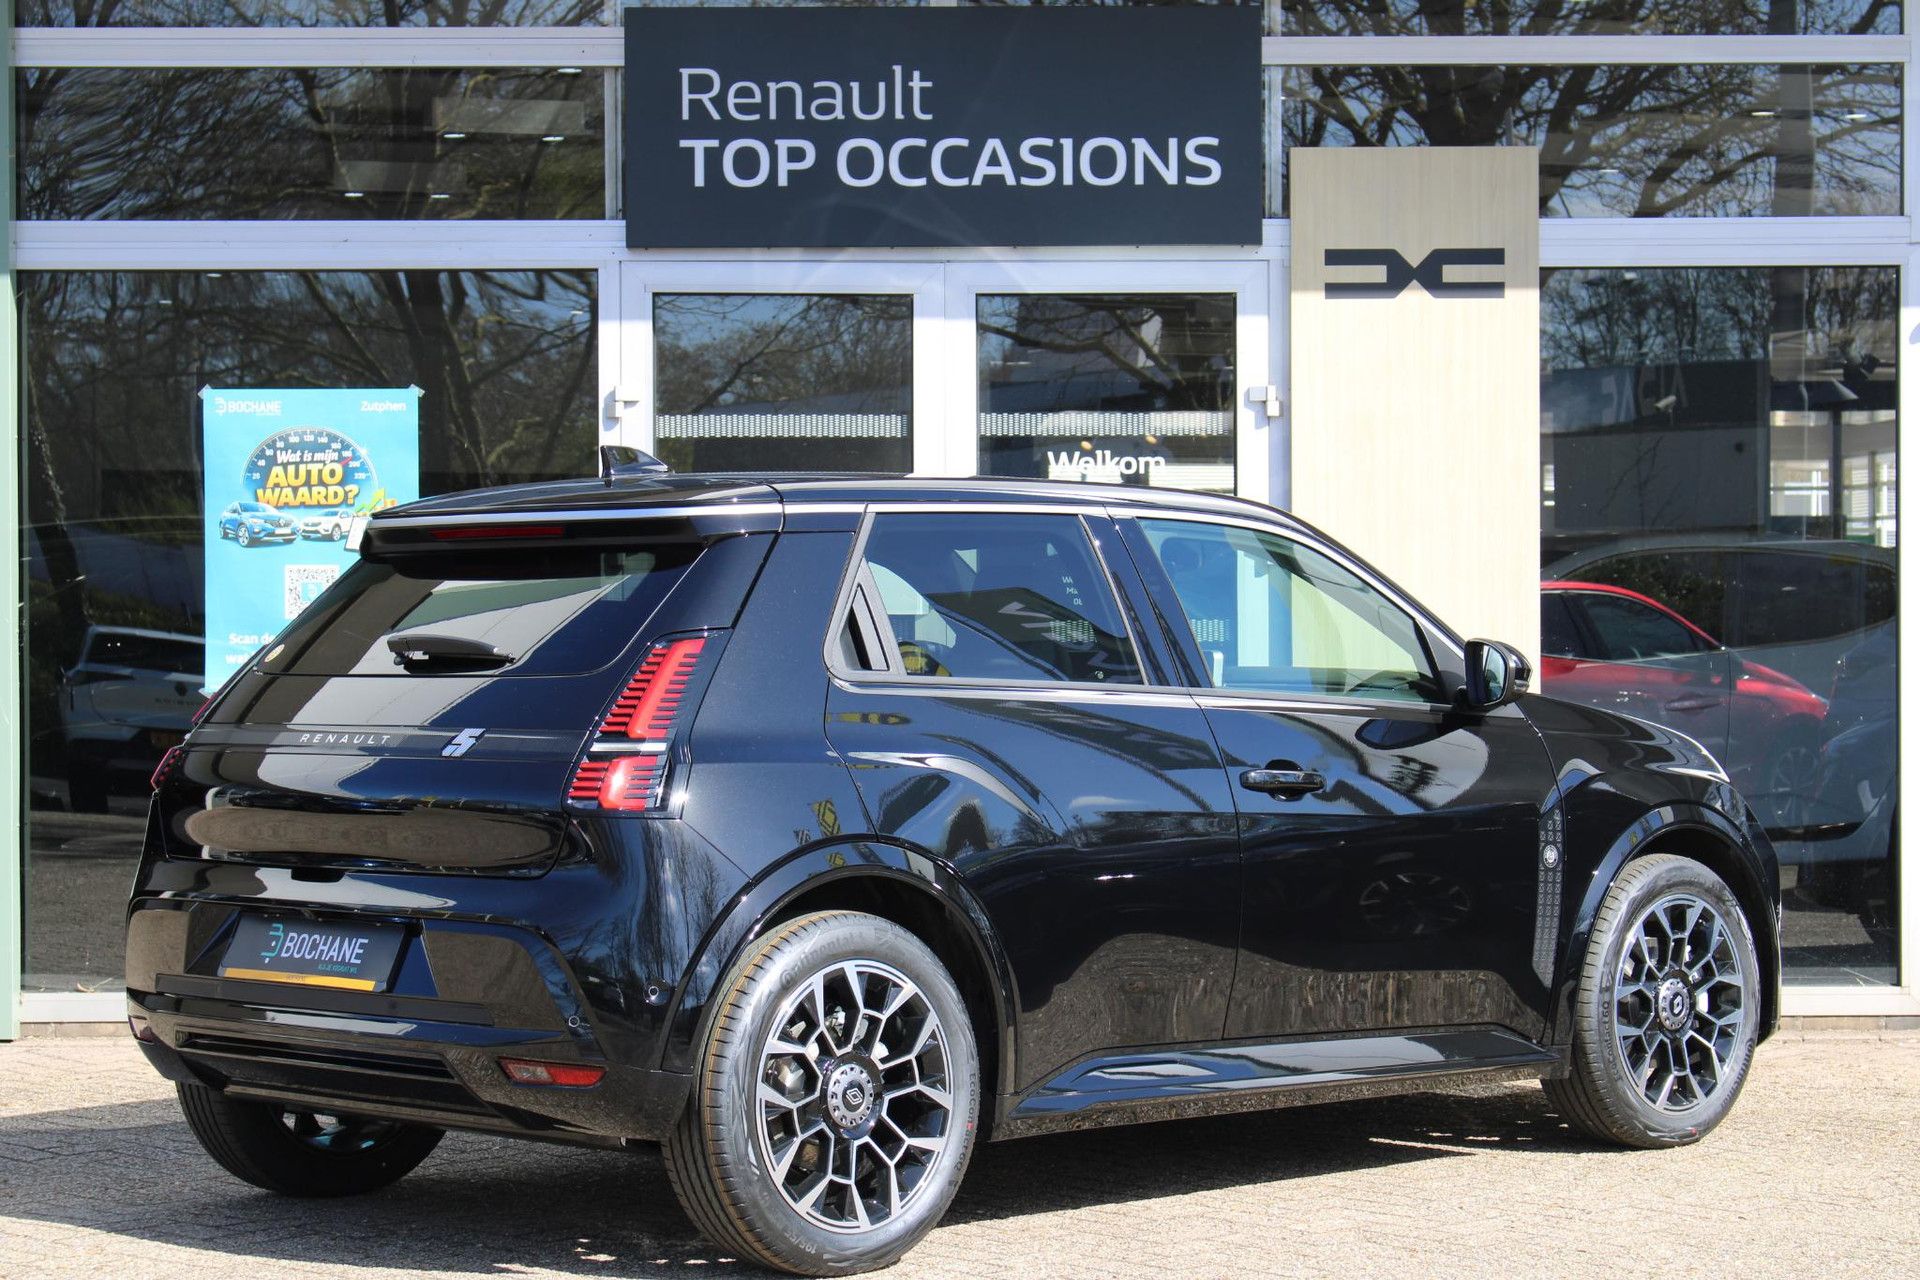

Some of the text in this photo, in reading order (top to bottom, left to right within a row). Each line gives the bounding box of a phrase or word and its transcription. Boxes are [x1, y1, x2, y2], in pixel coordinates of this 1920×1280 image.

[679, 64, 933, 121] Renault
[679, 136, 1222, 187] TOP OCCASIONS
[227, 400, 281, 413] BOCHANE
[360, 400, 406, 413] Zutphen
[303, 434, 314, 442] 120
[275, 449, 339, 464] Wat is mijn
[1047, 449, 1166, 475] Welkom
[267, 463, 343, 487] AUTO
[255, 484, 360, 507] WAARD?
[227, 632, 258, 645] Scan
[299, 732, 391, 745] RENAULT
[280, 931, 370, 964] BOCHANE
